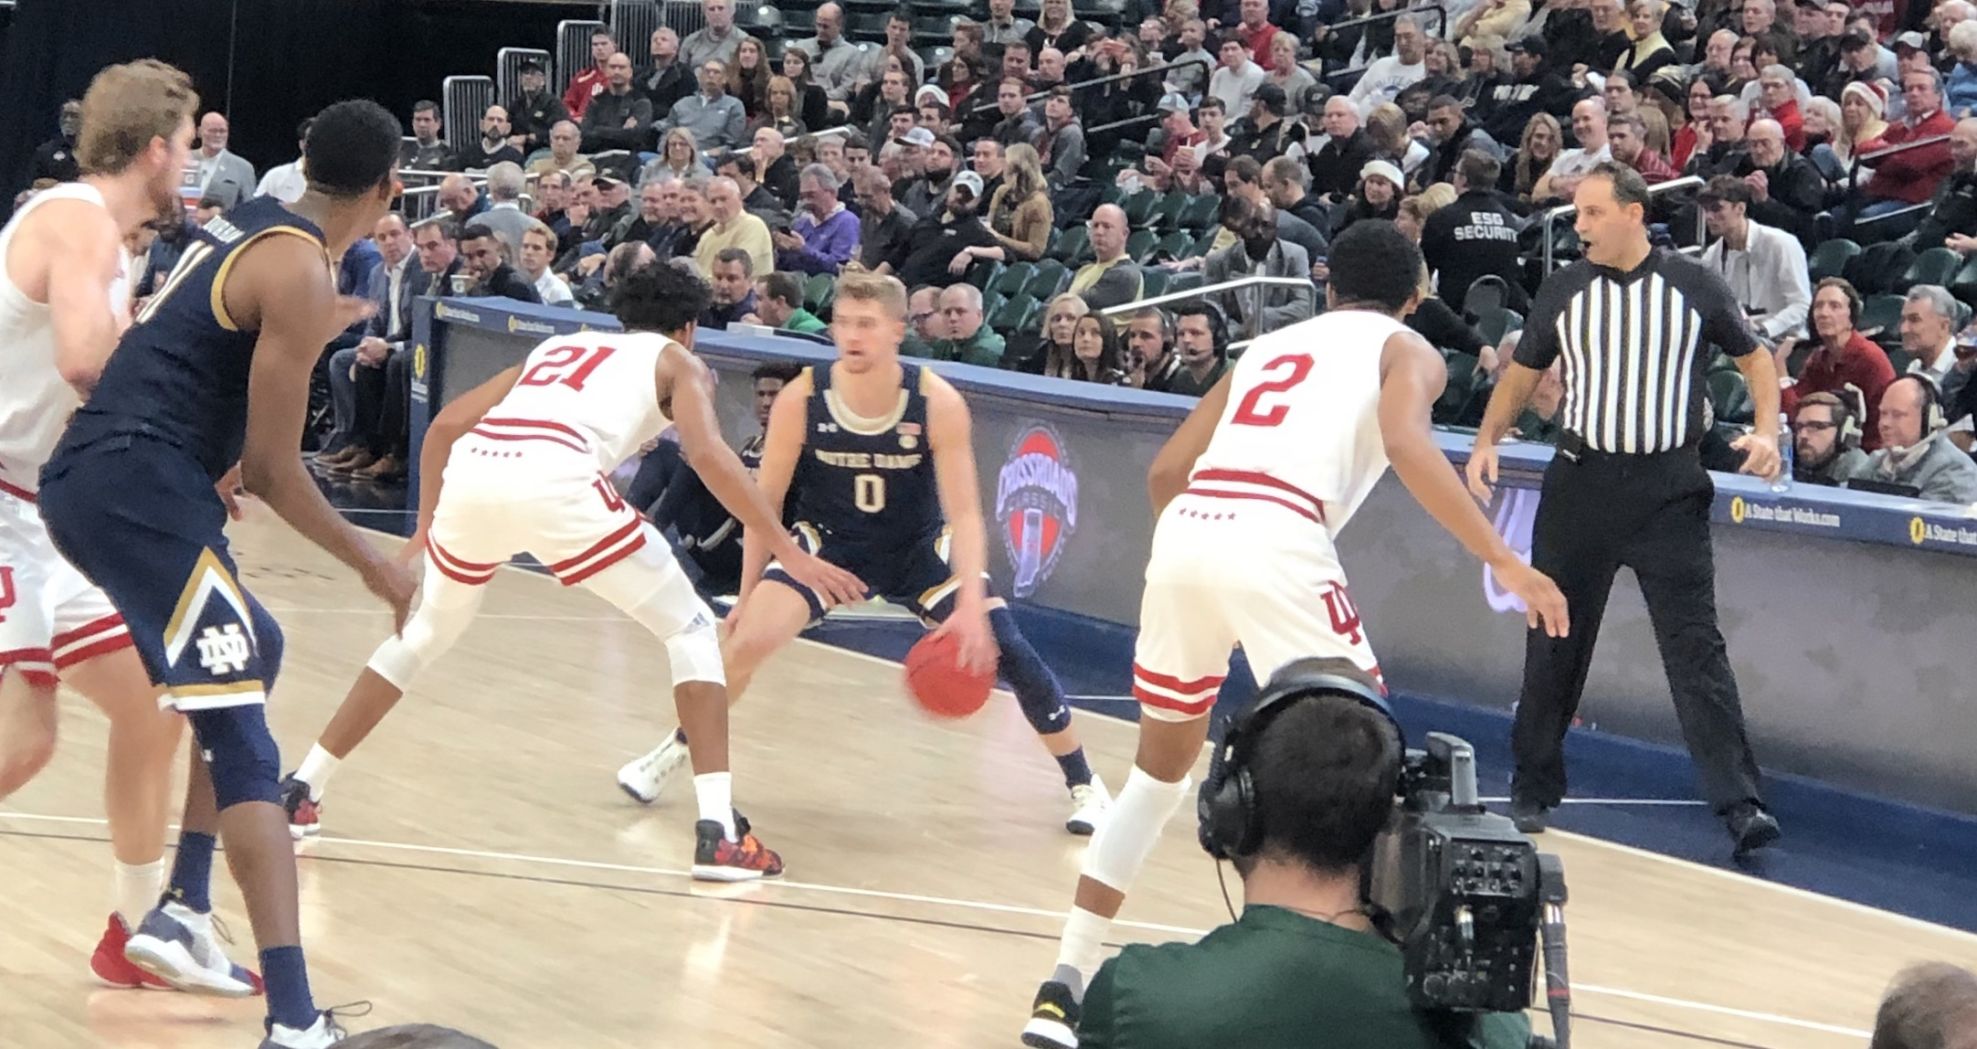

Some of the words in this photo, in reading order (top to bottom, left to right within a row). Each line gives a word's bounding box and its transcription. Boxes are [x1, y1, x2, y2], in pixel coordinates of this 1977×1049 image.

[1453, 225, 1519, 243] SECURITY
[517, 345, 616, 392] 21
[1230, 352, 1315, 427] 2
[853, 473, 886, 514] 0
